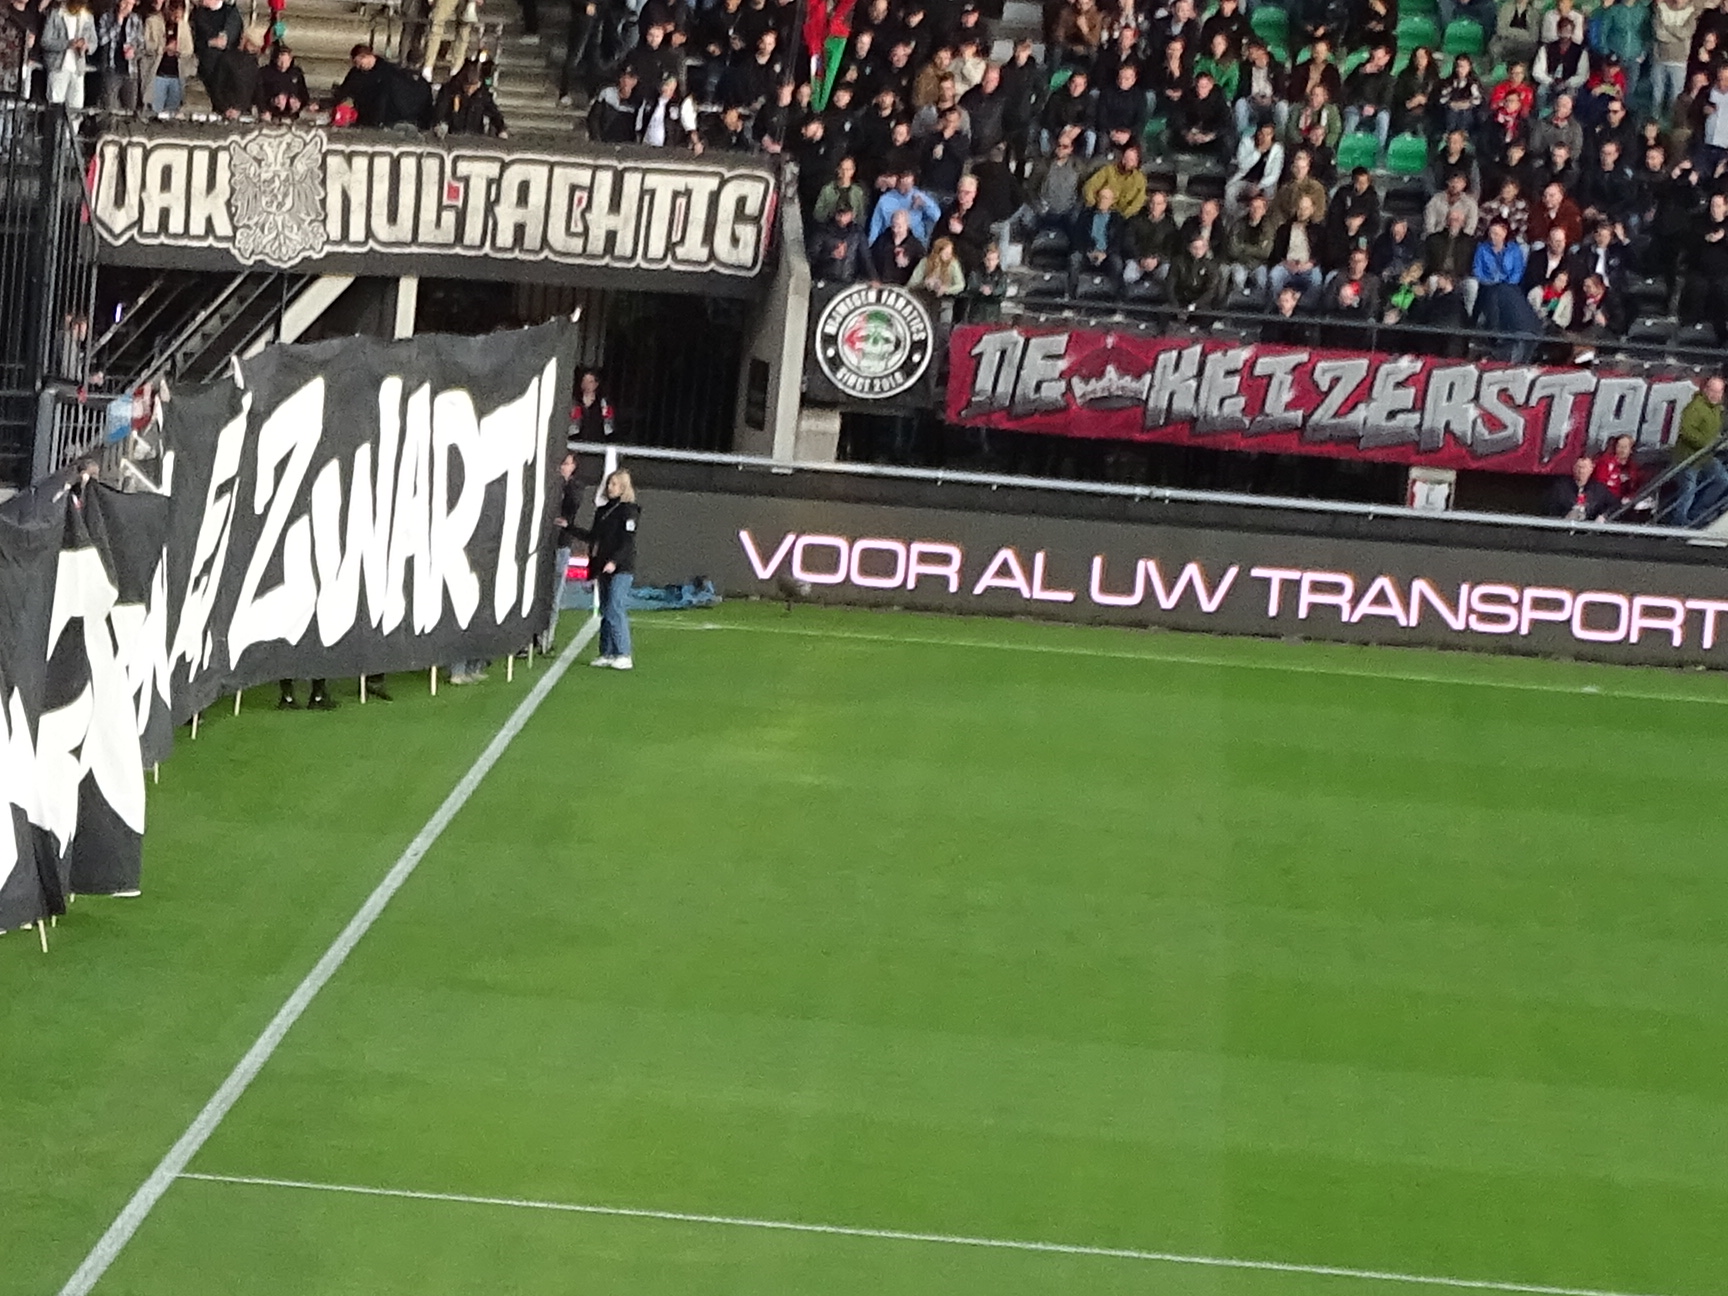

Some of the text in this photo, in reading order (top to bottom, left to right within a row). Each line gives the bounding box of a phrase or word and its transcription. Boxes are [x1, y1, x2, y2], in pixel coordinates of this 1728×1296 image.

[96, 138, 233, 238] VAK
[880, 290, 926, 341] FANATICS
[230, 357, 556, 670] ZWART!
[738, 530, 963, 593] VOOR
[973, 546, 1076, 602] AL
[1089, 554, 1240, 613] UW
